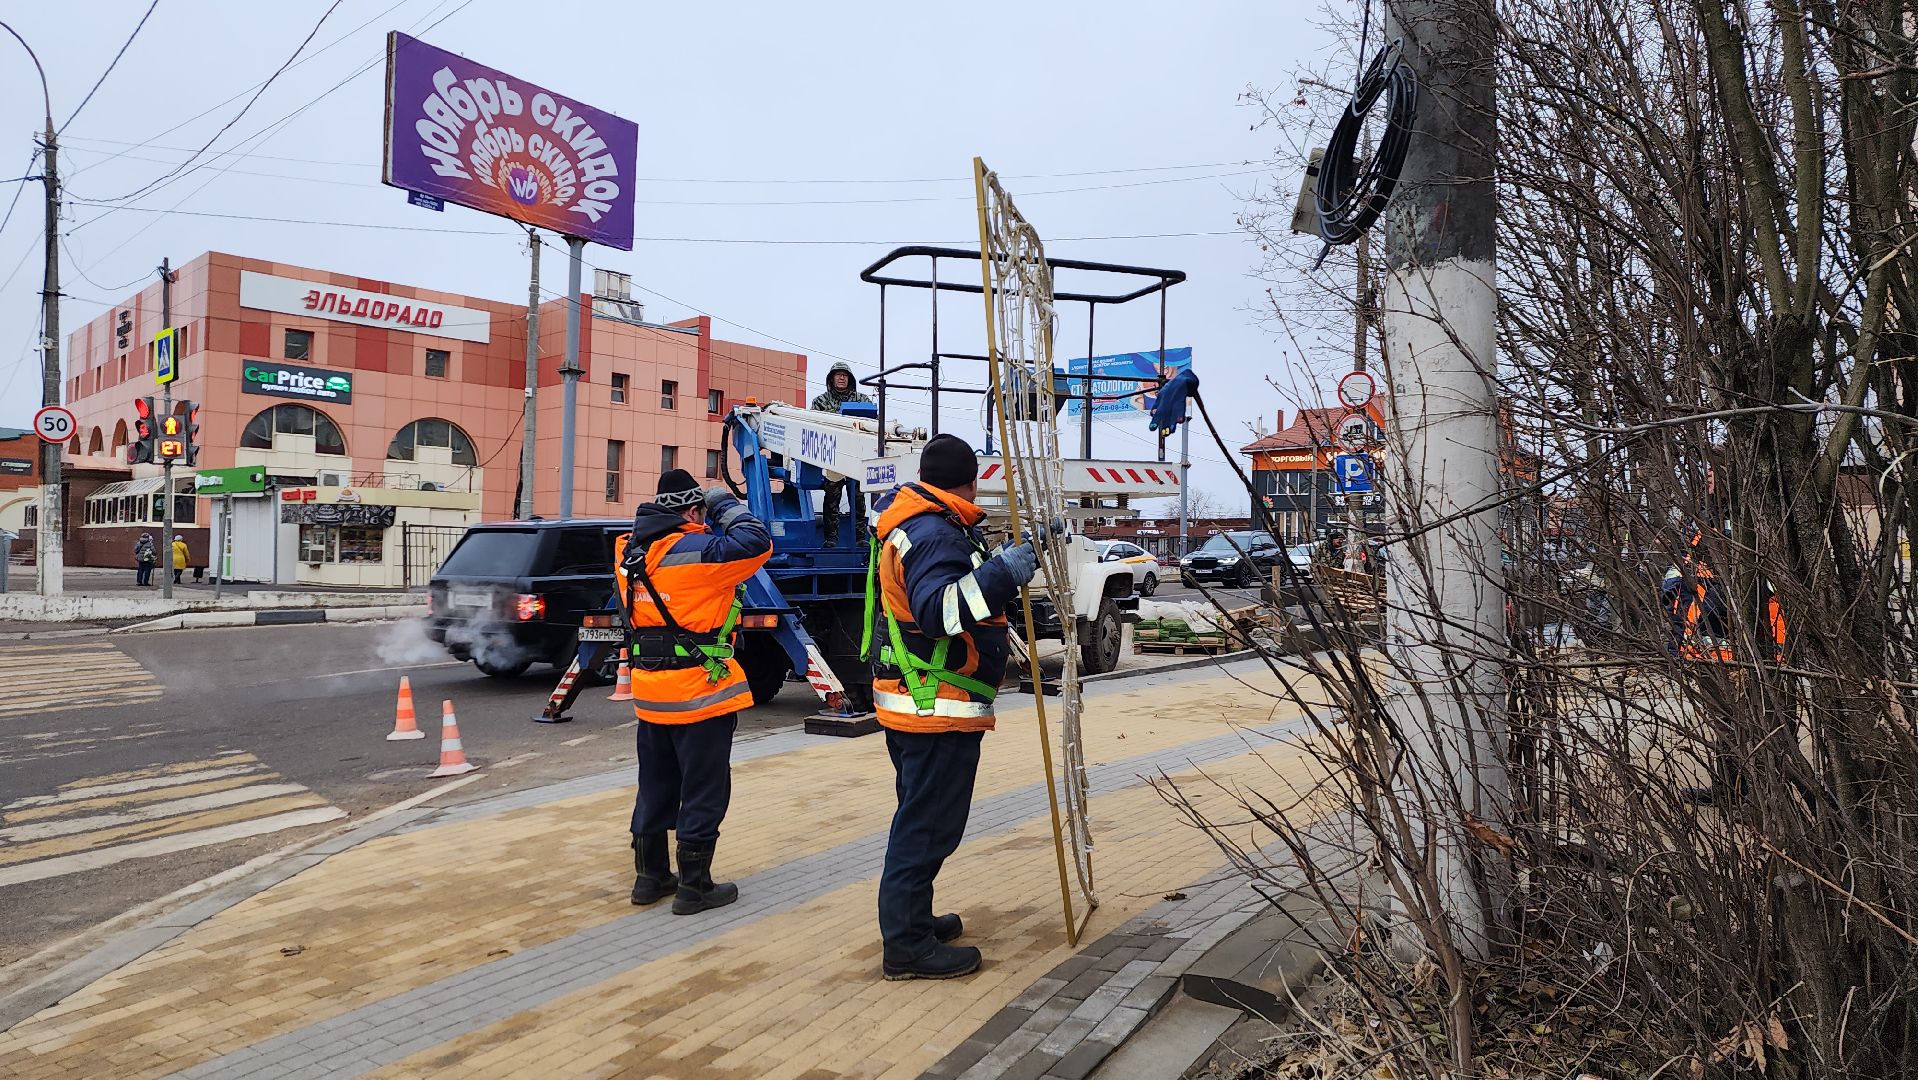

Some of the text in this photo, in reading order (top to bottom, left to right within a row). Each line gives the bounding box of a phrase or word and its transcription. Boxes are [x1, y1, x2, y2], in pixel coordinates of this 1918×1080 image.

[301, 289, 444, 328] ЭЛЬДОРАДО
[244, 366, 325, 390] CarPrice
[1071, 379, 1134, 396] СТАТОЛОГИЯ
[44, 417, 68, 432] 50
